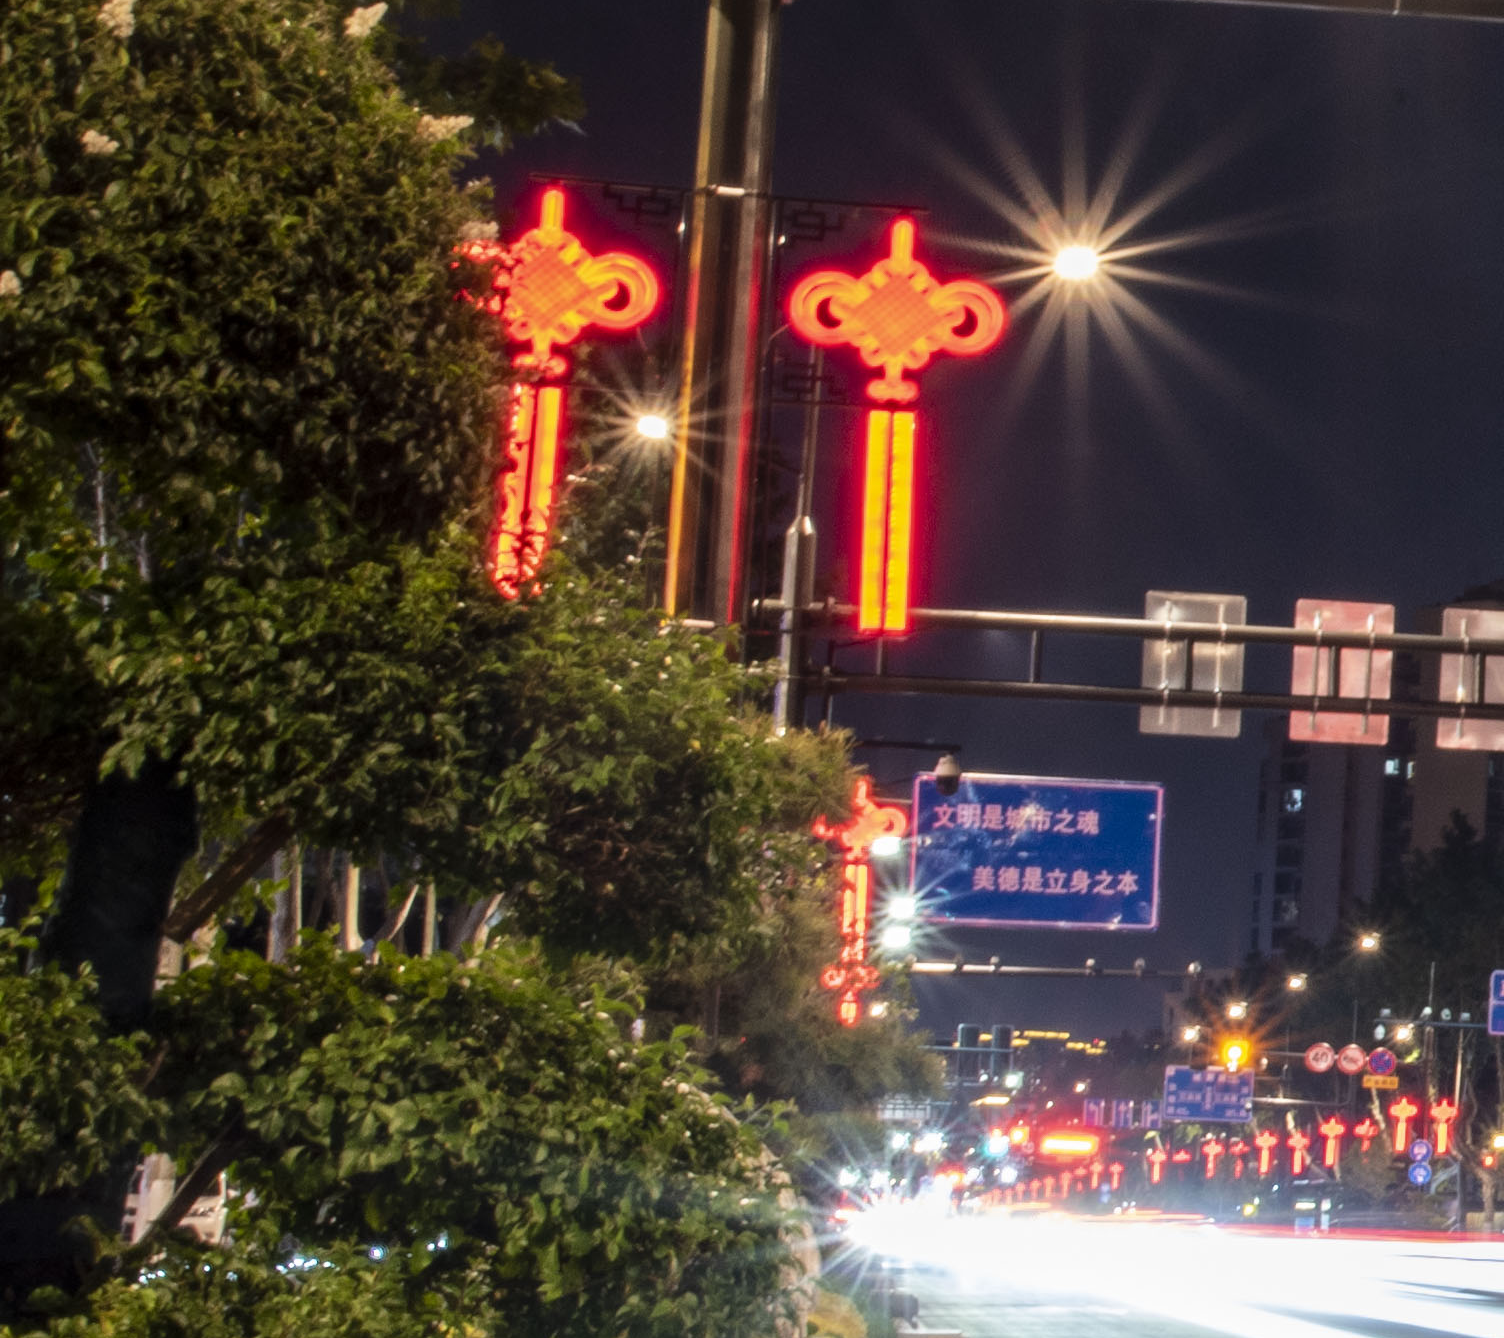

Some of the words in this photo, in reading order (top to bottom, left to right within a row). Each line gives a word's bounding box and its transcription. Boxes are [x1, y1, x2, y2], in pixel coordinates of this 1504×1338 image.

[932, 803, 1100, 836] 文明是城市之魂
[972, 864, 1139, 895] 美德是立身之本
